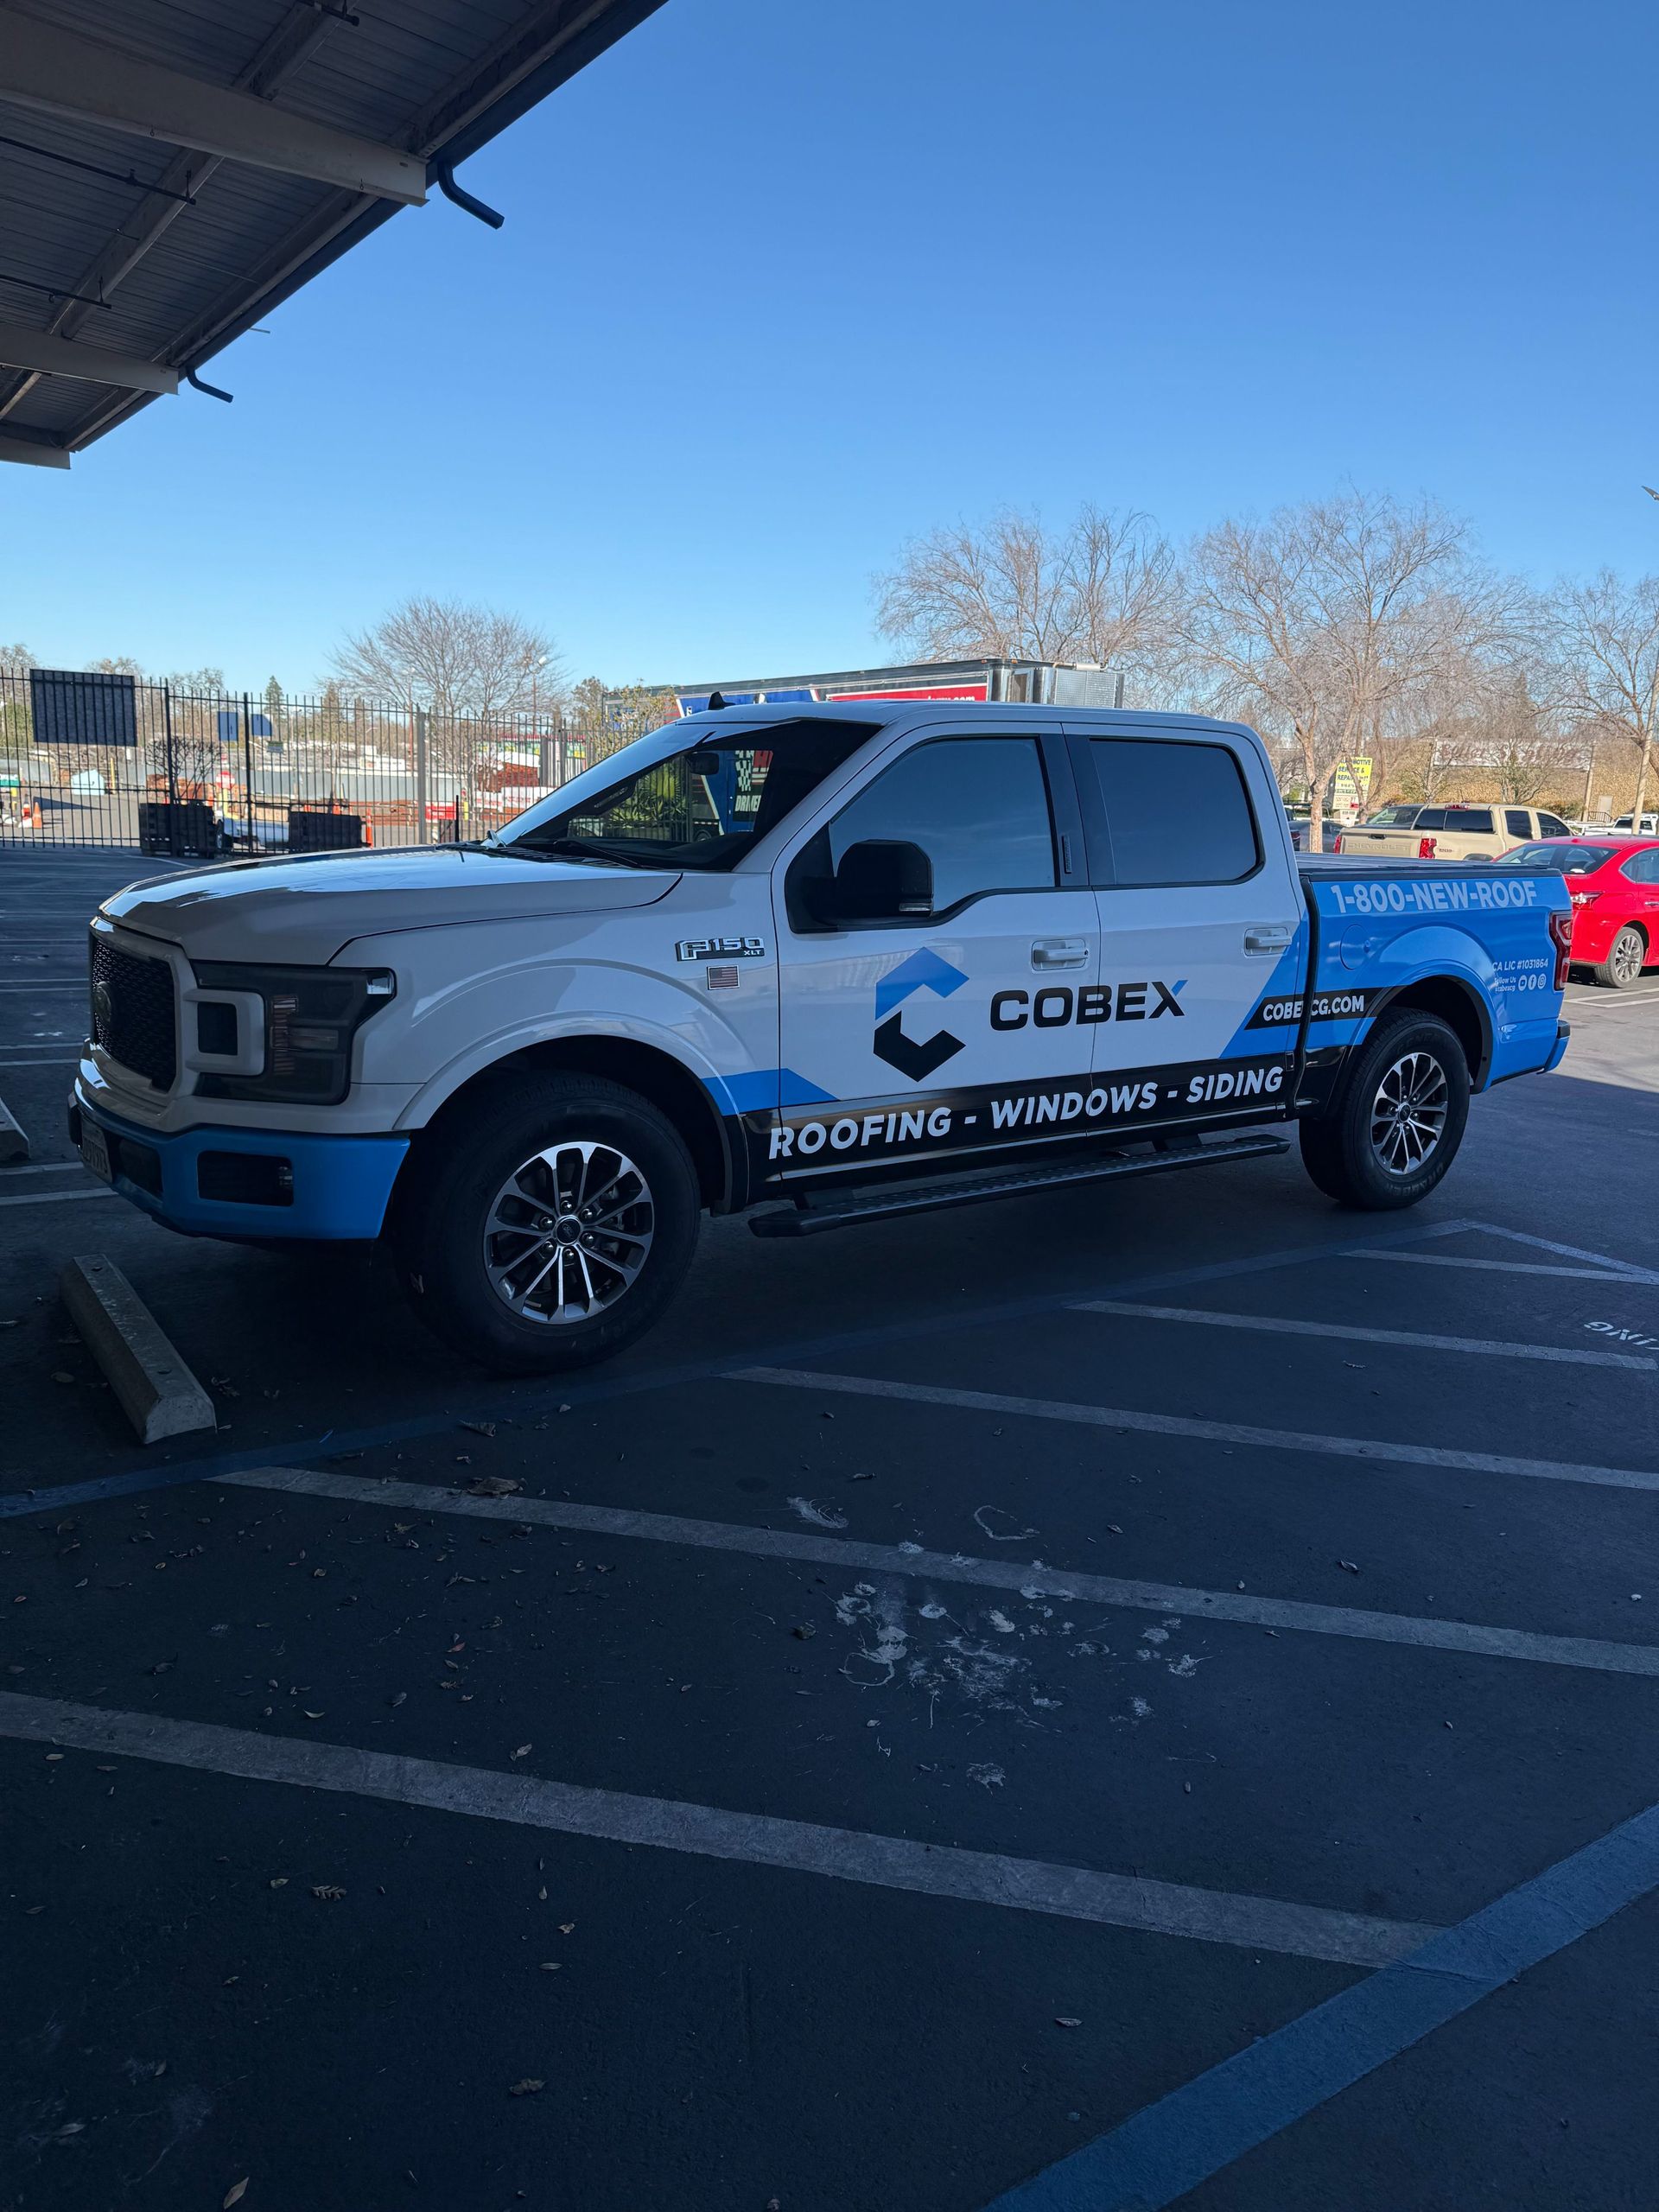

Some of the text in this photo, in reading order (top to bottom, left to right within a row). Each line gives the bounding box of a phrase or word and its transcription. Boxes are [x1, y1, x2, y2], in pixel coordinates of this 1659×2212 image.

[1331, 880, 1537, 913] 1-800-NEW-ROOF
[1503, 960, 1516, 970] LIC
[990, 980, 1188, 1031] COBEX
[1263, 995, 1364, 1021] COBECG.COM
[768, 1107, 951, 1160] ROOFING
[990, 1082, 1158, 1129] WINDOWS
[1186, 1066, 1283, 1103] SIDING
